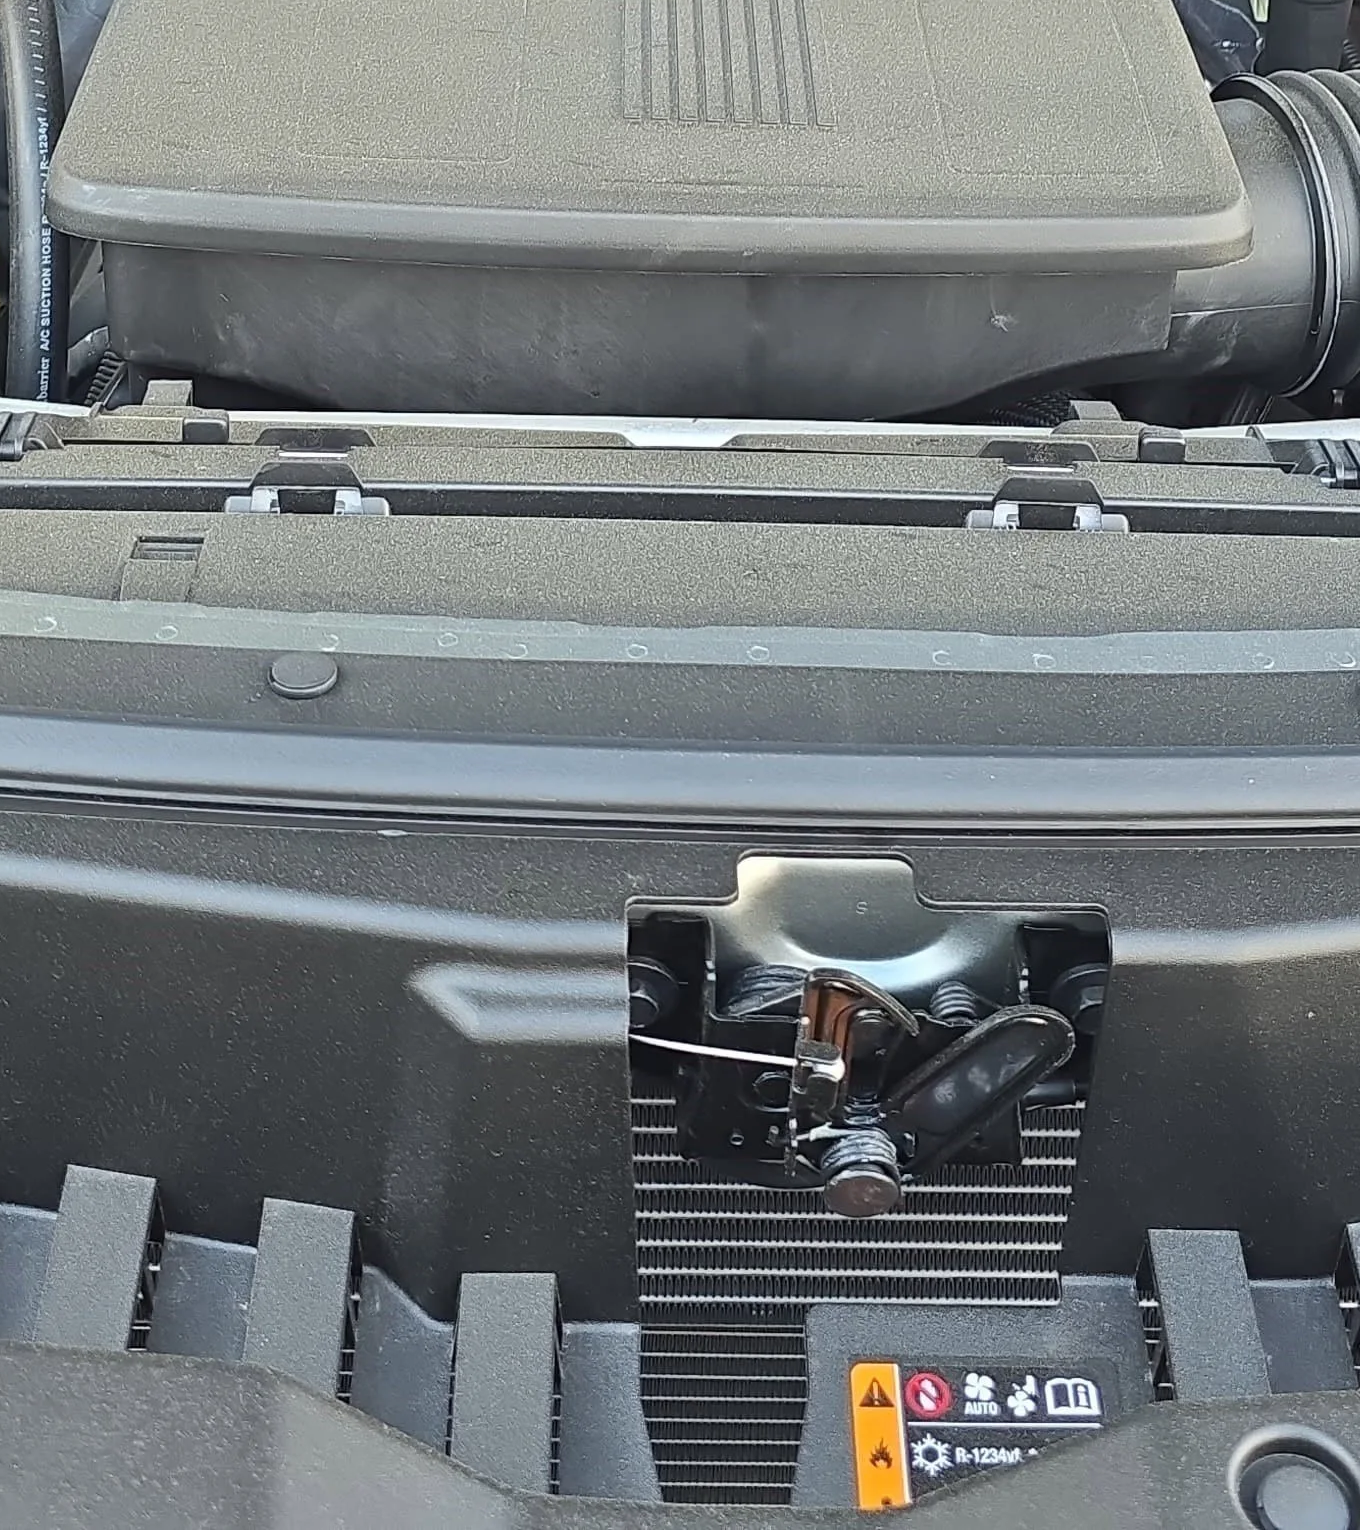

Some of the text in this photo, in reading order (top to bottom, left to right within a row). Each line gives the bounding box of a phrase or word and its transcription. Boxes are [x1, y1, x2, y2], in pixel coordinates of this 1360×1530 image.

[42, 227, 52, 267] HOSE
[41, 269, 52, 327] SUCTION
[40, 328, 51, 351] A/C
[964, 1401, 1000, 1416] AUTO
